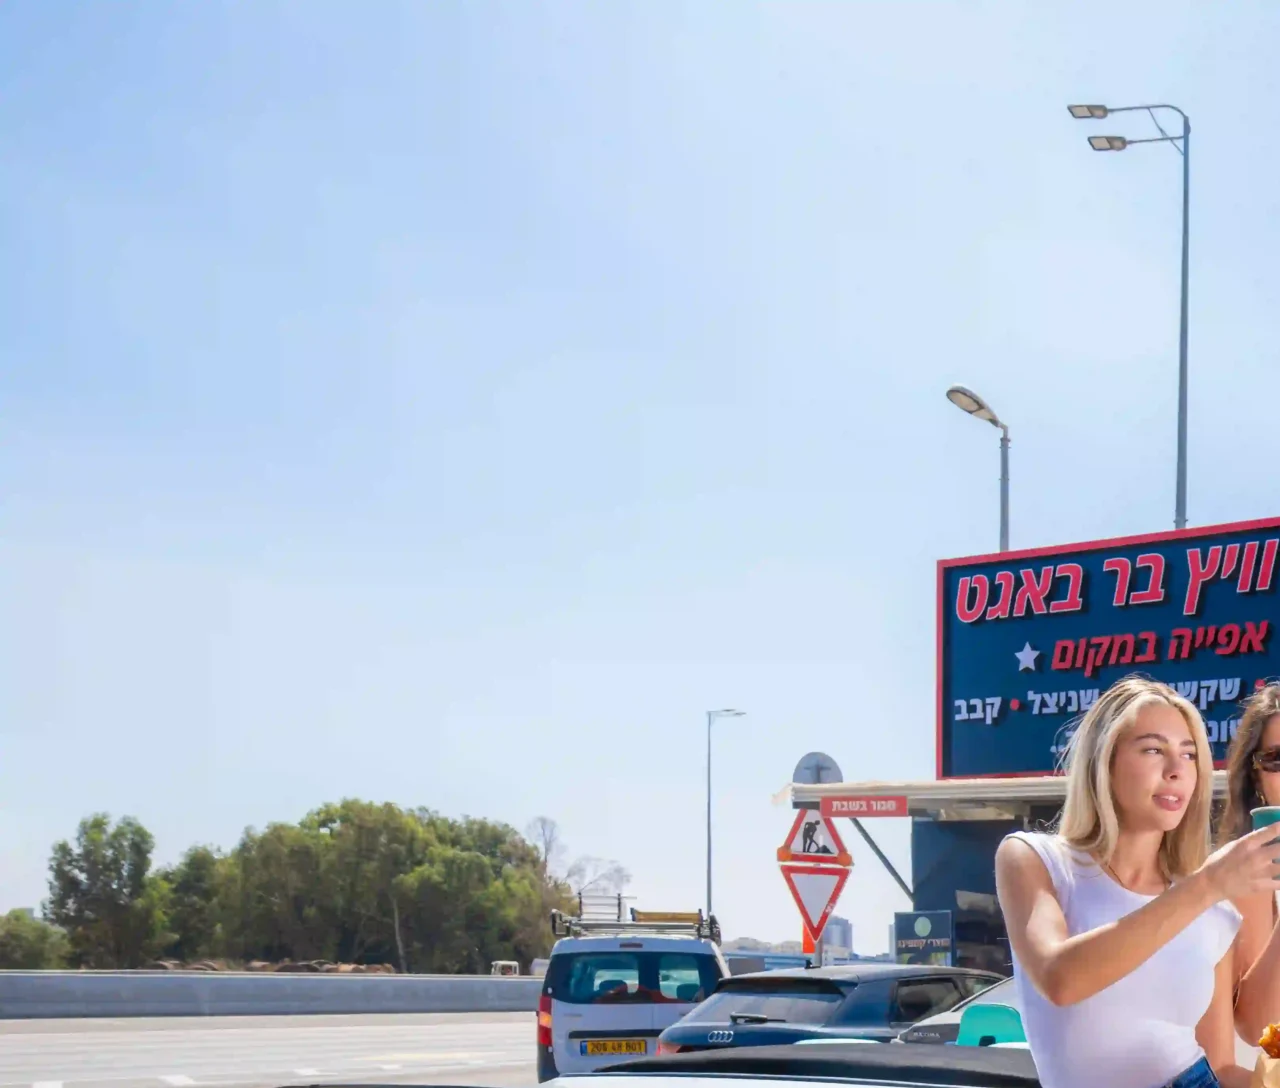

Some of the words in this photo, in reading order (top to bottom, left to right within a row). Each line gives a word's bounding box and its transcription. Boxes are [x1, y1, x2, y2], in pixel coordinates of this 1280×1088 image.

[956, 563, 1083, 623] באגט
[1103, 553, 1165, 606] בר
[1051, 631, 1156, 678] במקום
[1168, 620, 1269, 660] אפייה
[955, 696, 1002, 724] קבב
[1027, 689, 1099, 715] שניצל
[832, 800, 867, 812] בשבת
